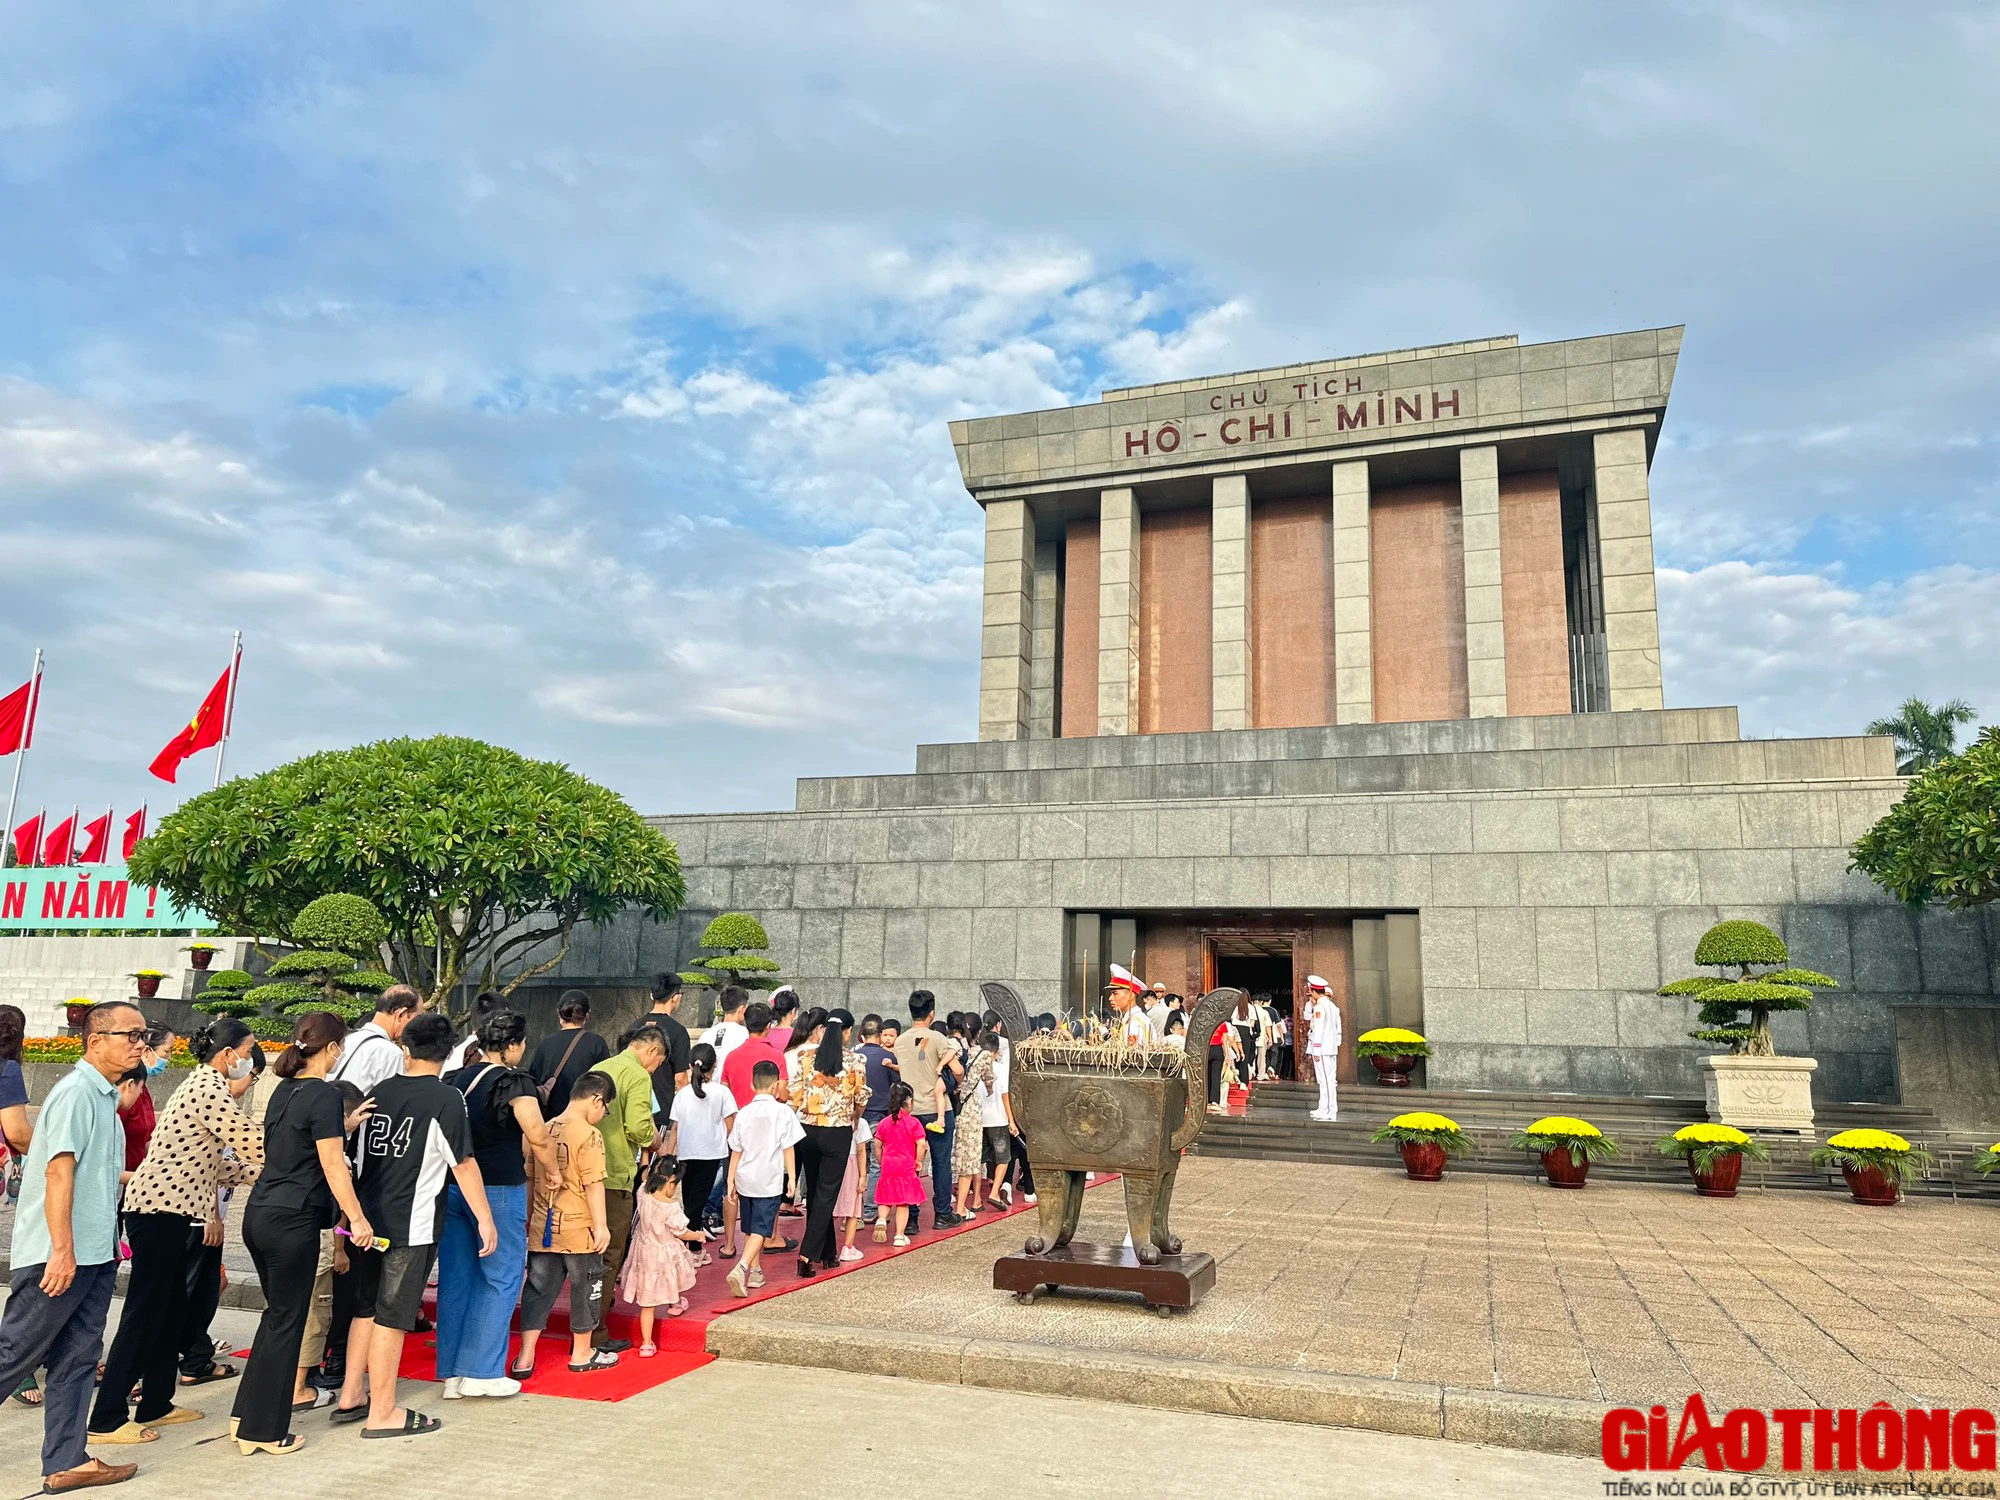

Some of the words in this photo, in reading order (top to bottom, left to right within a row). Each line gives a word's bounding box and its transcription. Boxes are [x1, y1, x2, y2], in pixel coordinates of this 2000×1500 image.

[1210, 383, 1268, 411] CHỦ
[1292, 376, 1362, 405] TỊCH
[1125, 419, 1183, 457] HỒ
[1220, 404, 1295, 445] CHÍ
[1337, 389, 1460, 431] MINH
[41, 872, 129, 919] NĂM
[368, 1113, 414, 1158] 24
